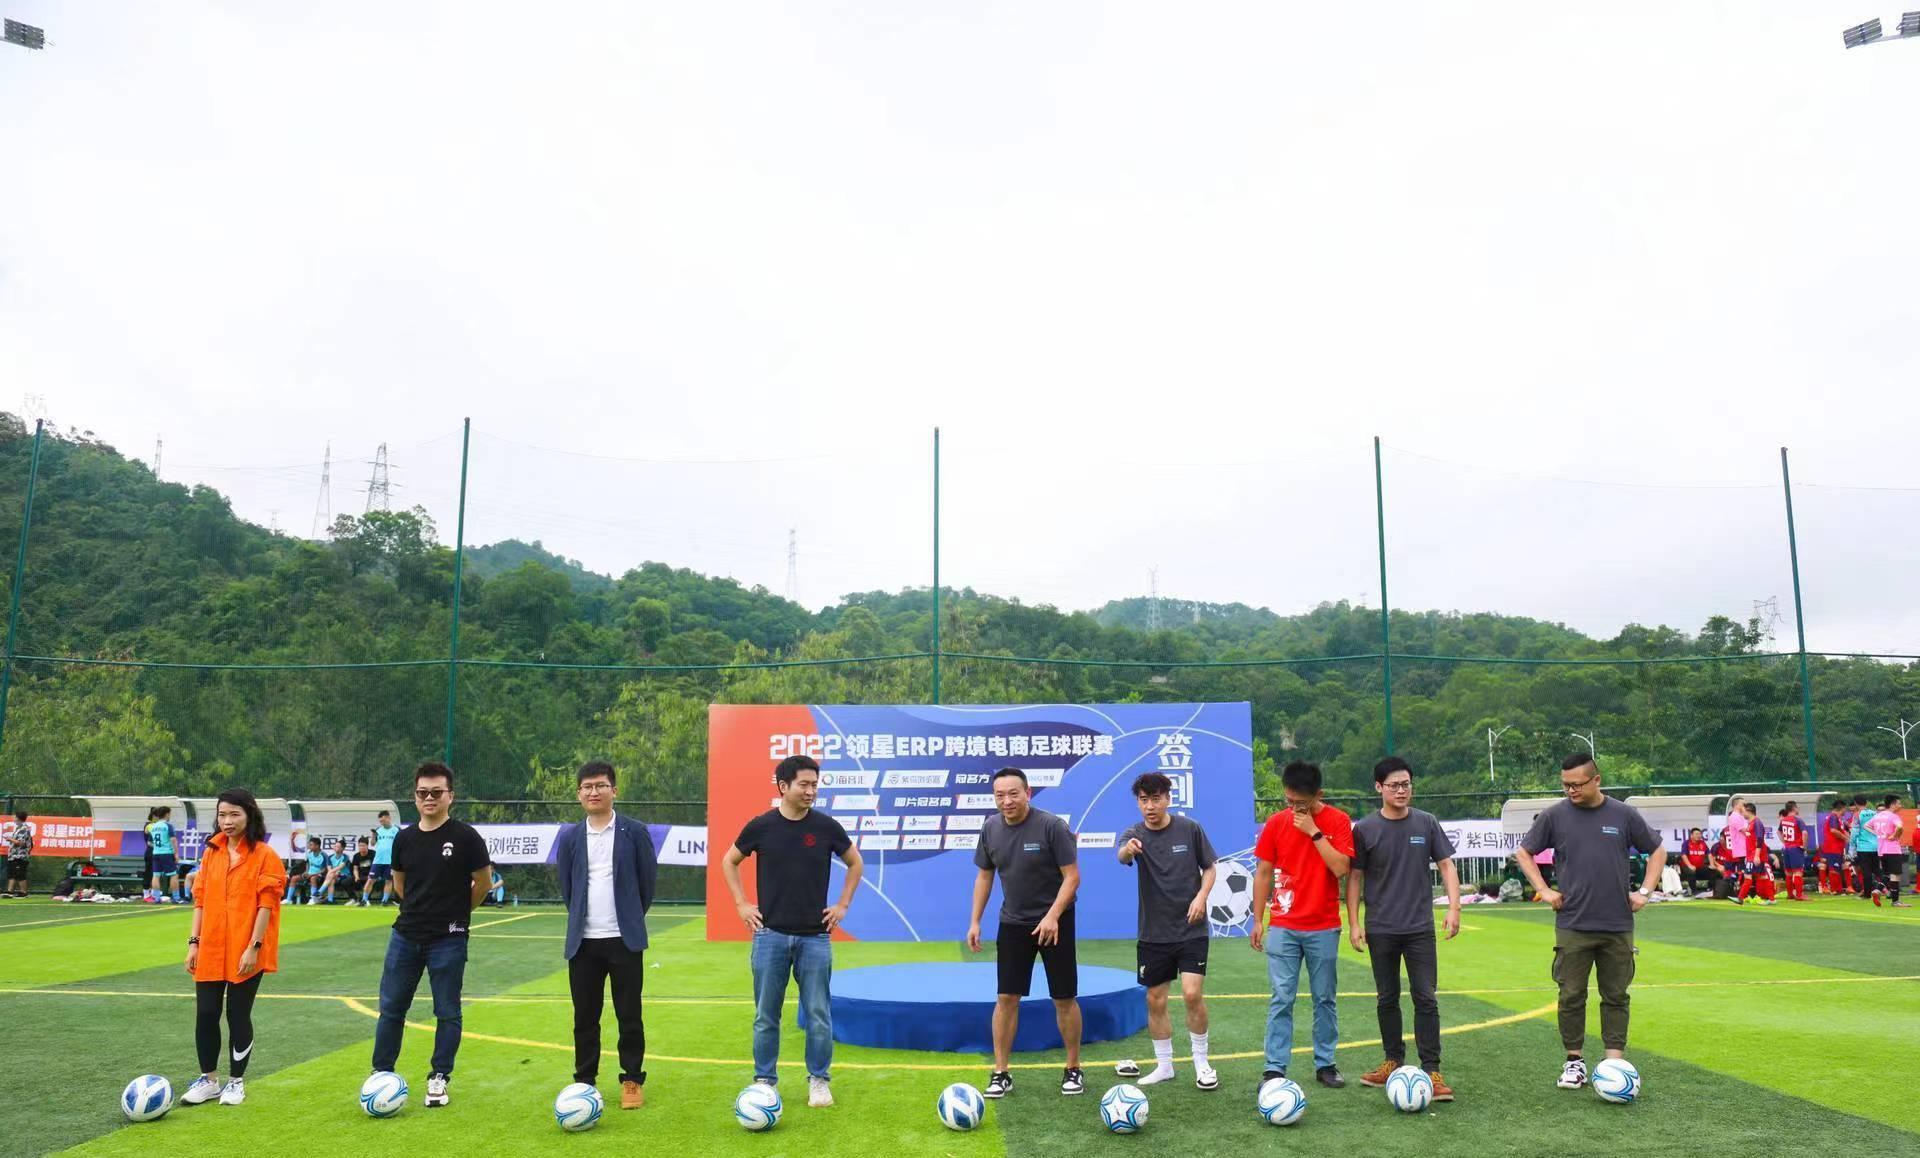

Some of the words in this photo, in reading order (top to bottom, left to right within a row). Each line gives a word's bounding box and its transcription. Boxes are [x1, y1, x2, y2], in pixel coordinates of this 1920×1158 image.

[769, 734, 842, 760] 2022
[846, 734, 1114, 759] 领星ERP跨境电商足球联赛
[1782, 826, 1795, 841] 99
